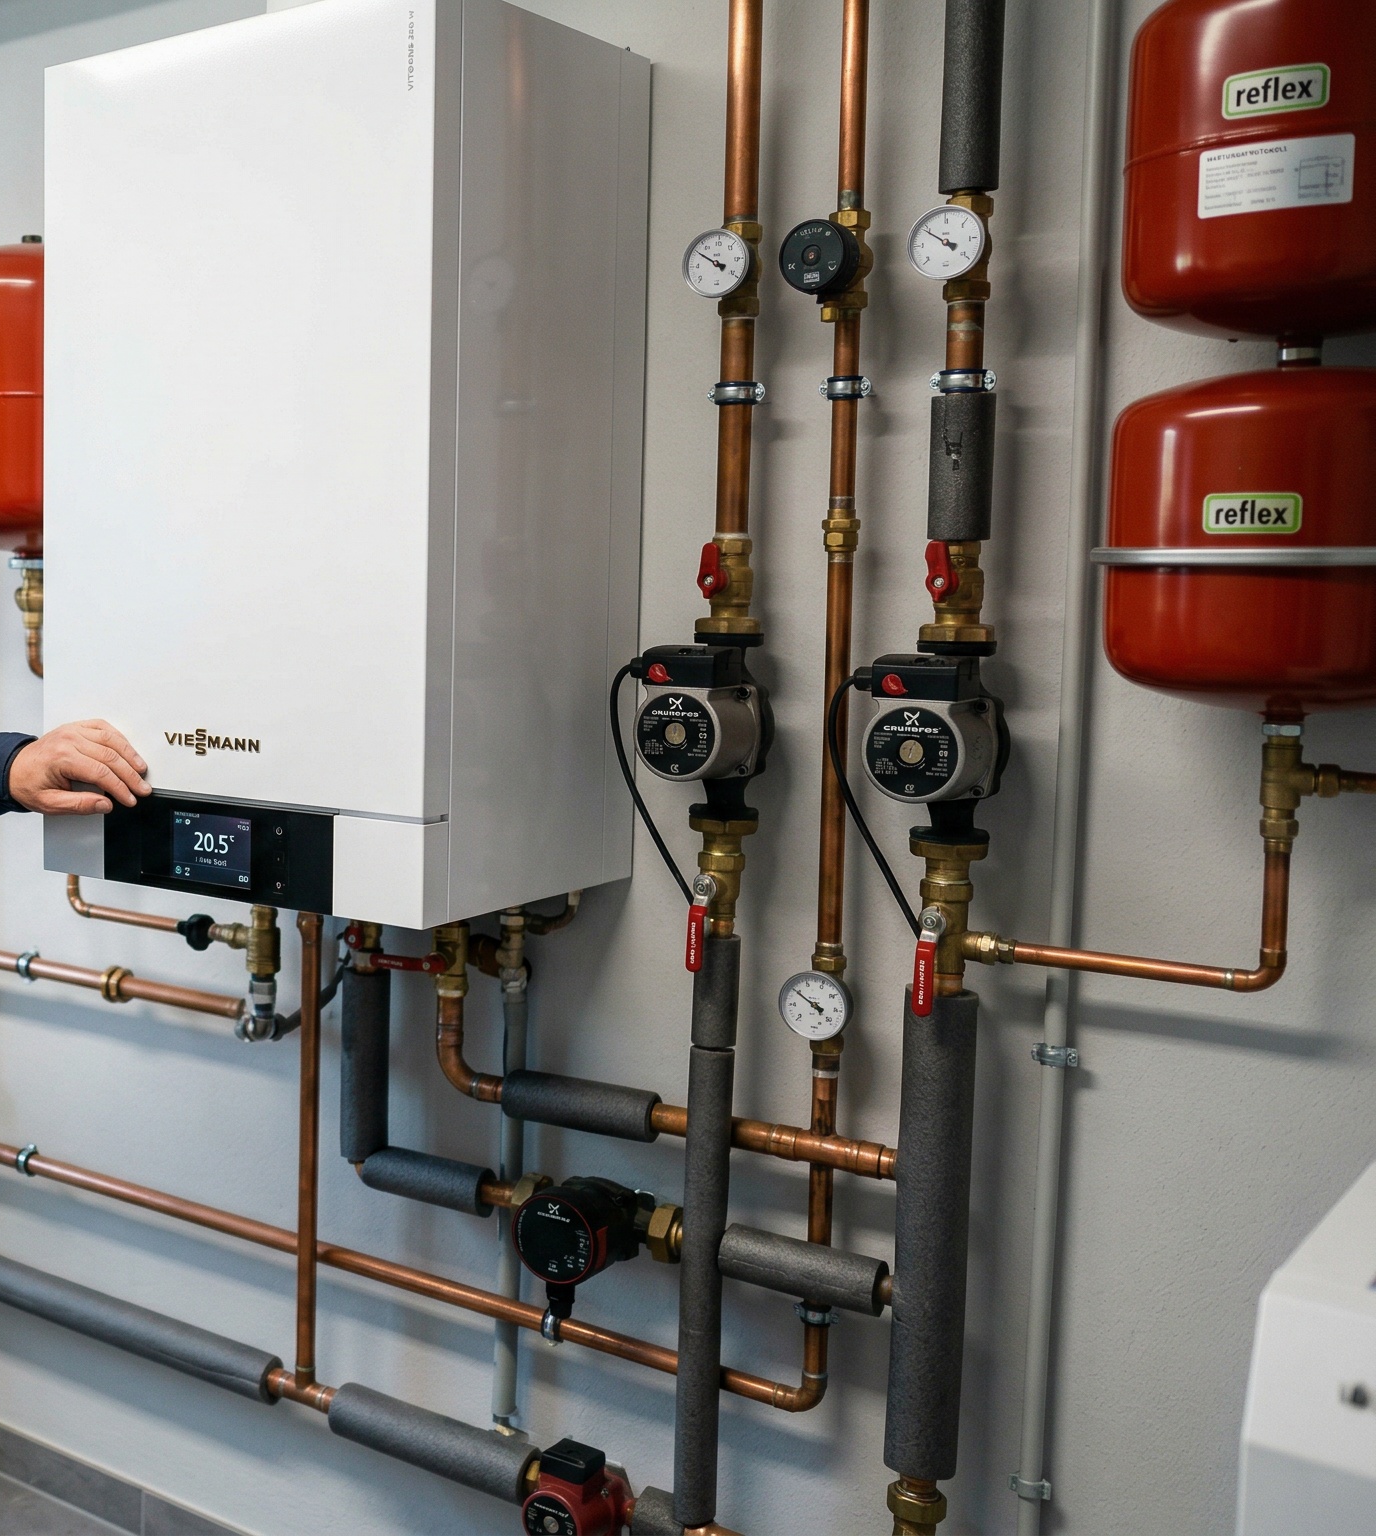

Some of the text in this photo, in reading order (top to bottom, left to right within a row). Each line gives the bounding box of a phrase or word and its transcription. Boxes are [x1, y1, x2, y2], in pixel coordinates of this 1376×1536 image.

[1236, 76, 1313, 107] reflex
[1215, 499, 1288, 525] reflex
[164, 728, 260, 756] VIESSMANN
